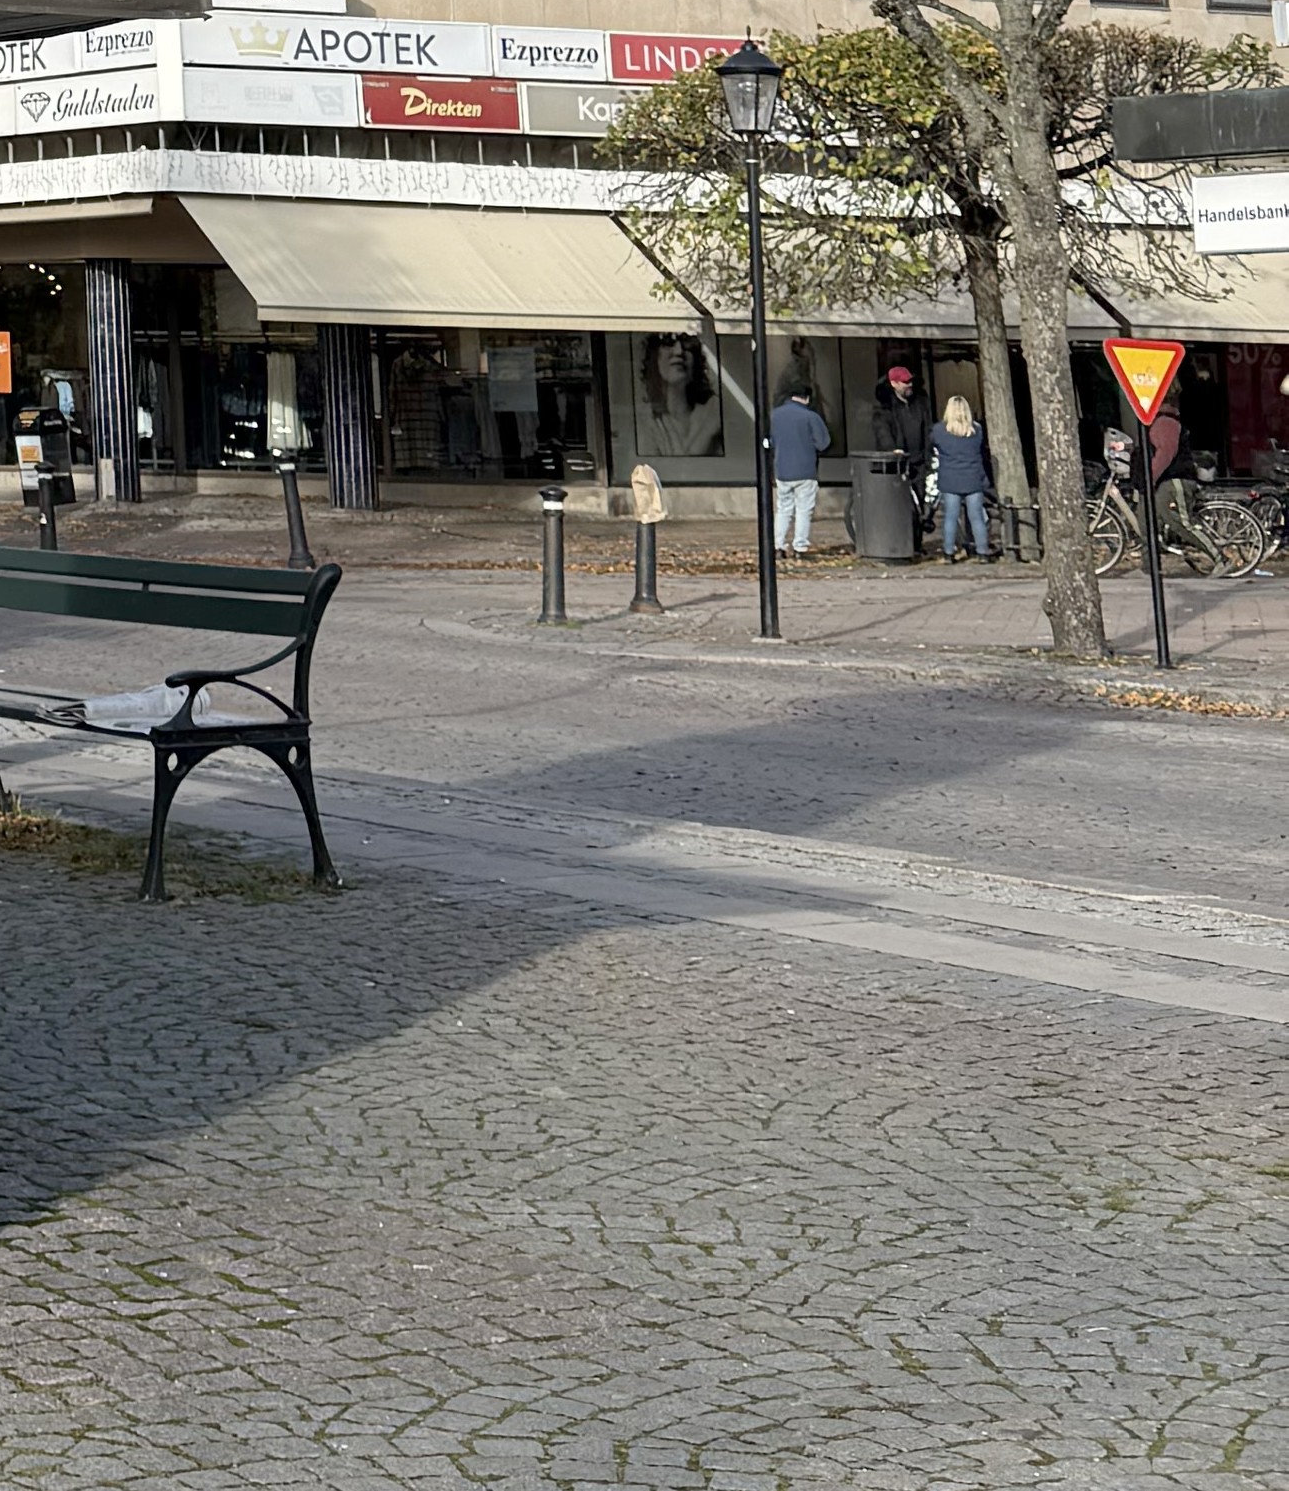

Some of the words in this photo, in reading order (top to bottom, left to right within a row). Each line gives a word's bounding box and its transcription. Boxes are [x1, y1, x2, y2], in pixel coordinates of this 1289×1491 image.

[85, 30, 154, 57] Ezprezzo
[294, 27, 439, 66] APOTEK
[501, 38, 599, 66] Ezprezzo
[53, 83, 155, 121] Guldstaden
[400, 87, 482, 117] Direkten
